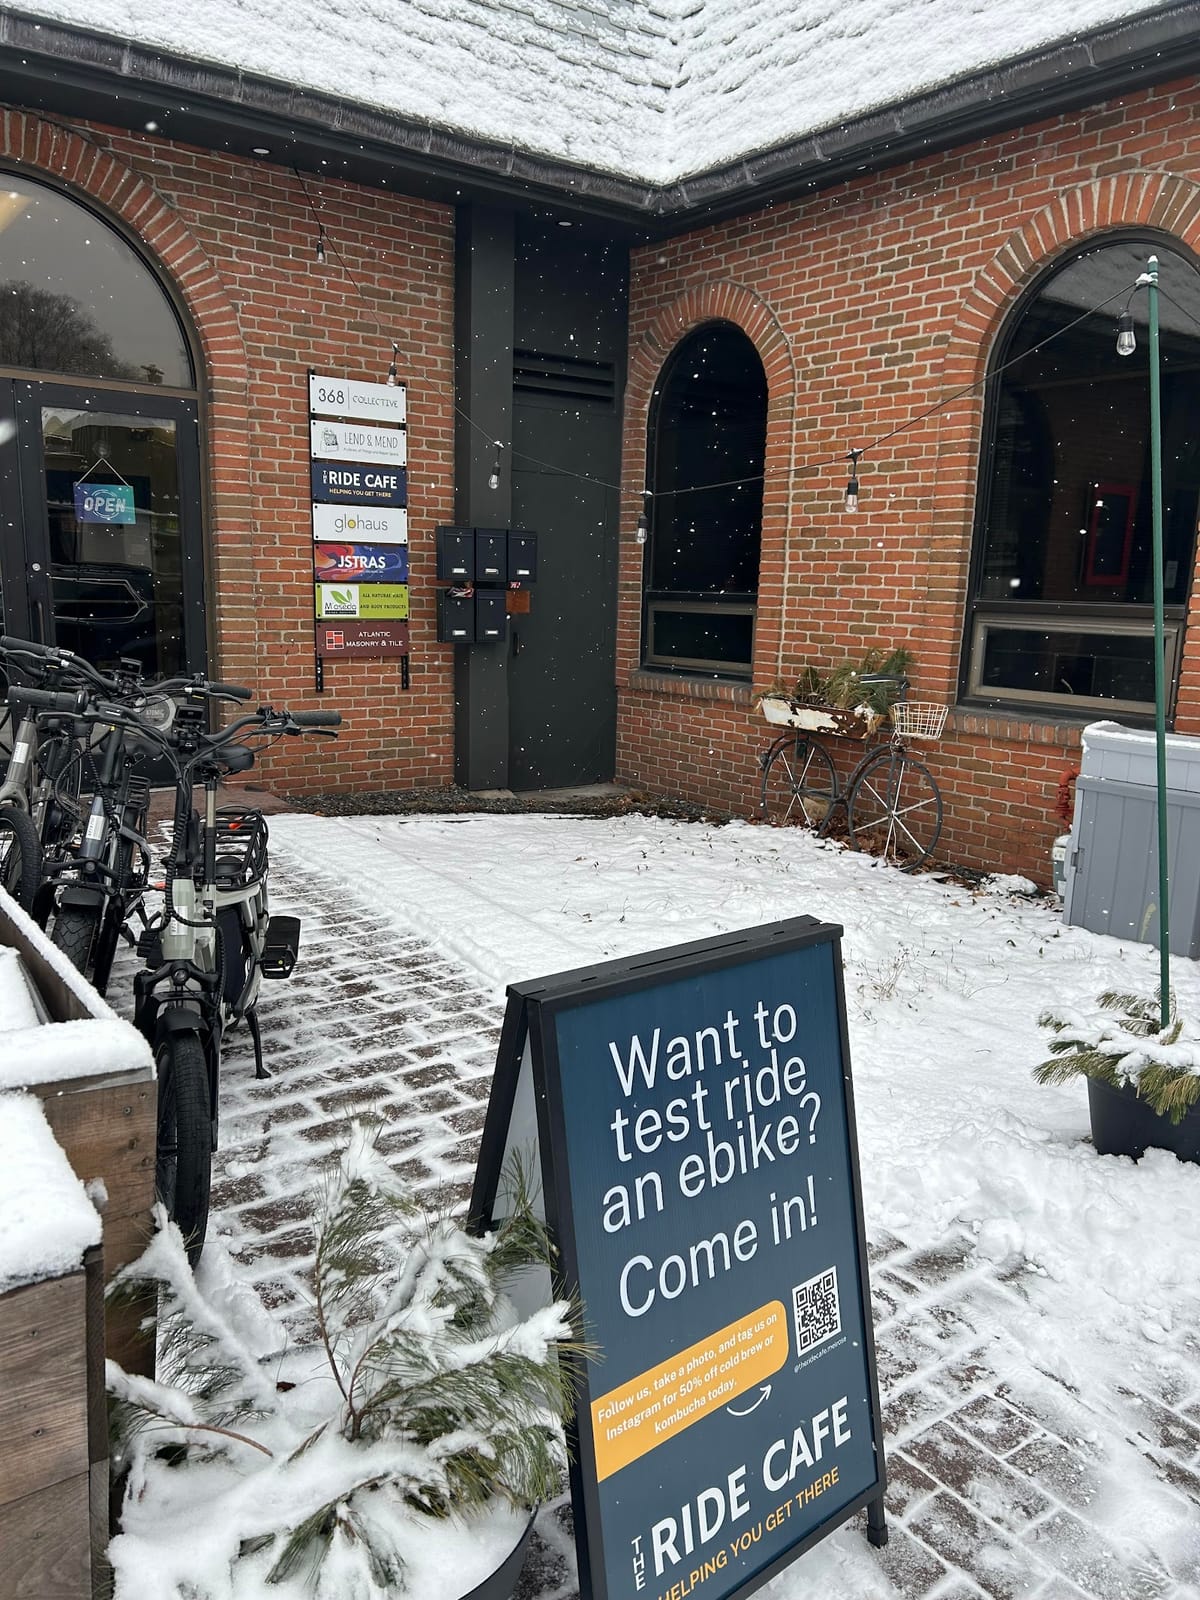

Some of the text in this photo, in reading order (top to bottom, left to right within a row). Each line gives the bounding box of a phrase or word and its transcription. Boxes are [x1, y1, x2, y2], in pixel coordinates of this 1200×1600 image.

[318, 388, 398, 408] 368 COLLECTIVE
[344, 432, 398, 448] LEND & MEND
[84, 497, 126, 512] OPEN
[329, 471, 360, 486] RIDE
[364, 474, 397, 489] CAFE
[334, 514, 388, 533] glohaus
[338, 555, 386, 569] JSTRAS
[609, 1001, 797, 1097] Want to
[610, 1049, 807, 1162] test ride
[603, 1092, 821, 1233] an ebike?
[620, 1174, 818, 1317] Come in!
[598, 1313, 777, 1424] Follow us, take a photo, and tag us on
[606, 1334, 774, 1440] Instagram for 50% off cold brew or
[654, 1376, 737, 1434] kombucha today.
[631, 1396, 852, 1591] THE RIDE CAFE
[730, 1522, 762, 1558] YOU
[765, 1500, 793, 1532] GET
[795, 1466, 840, 1509] THERE
